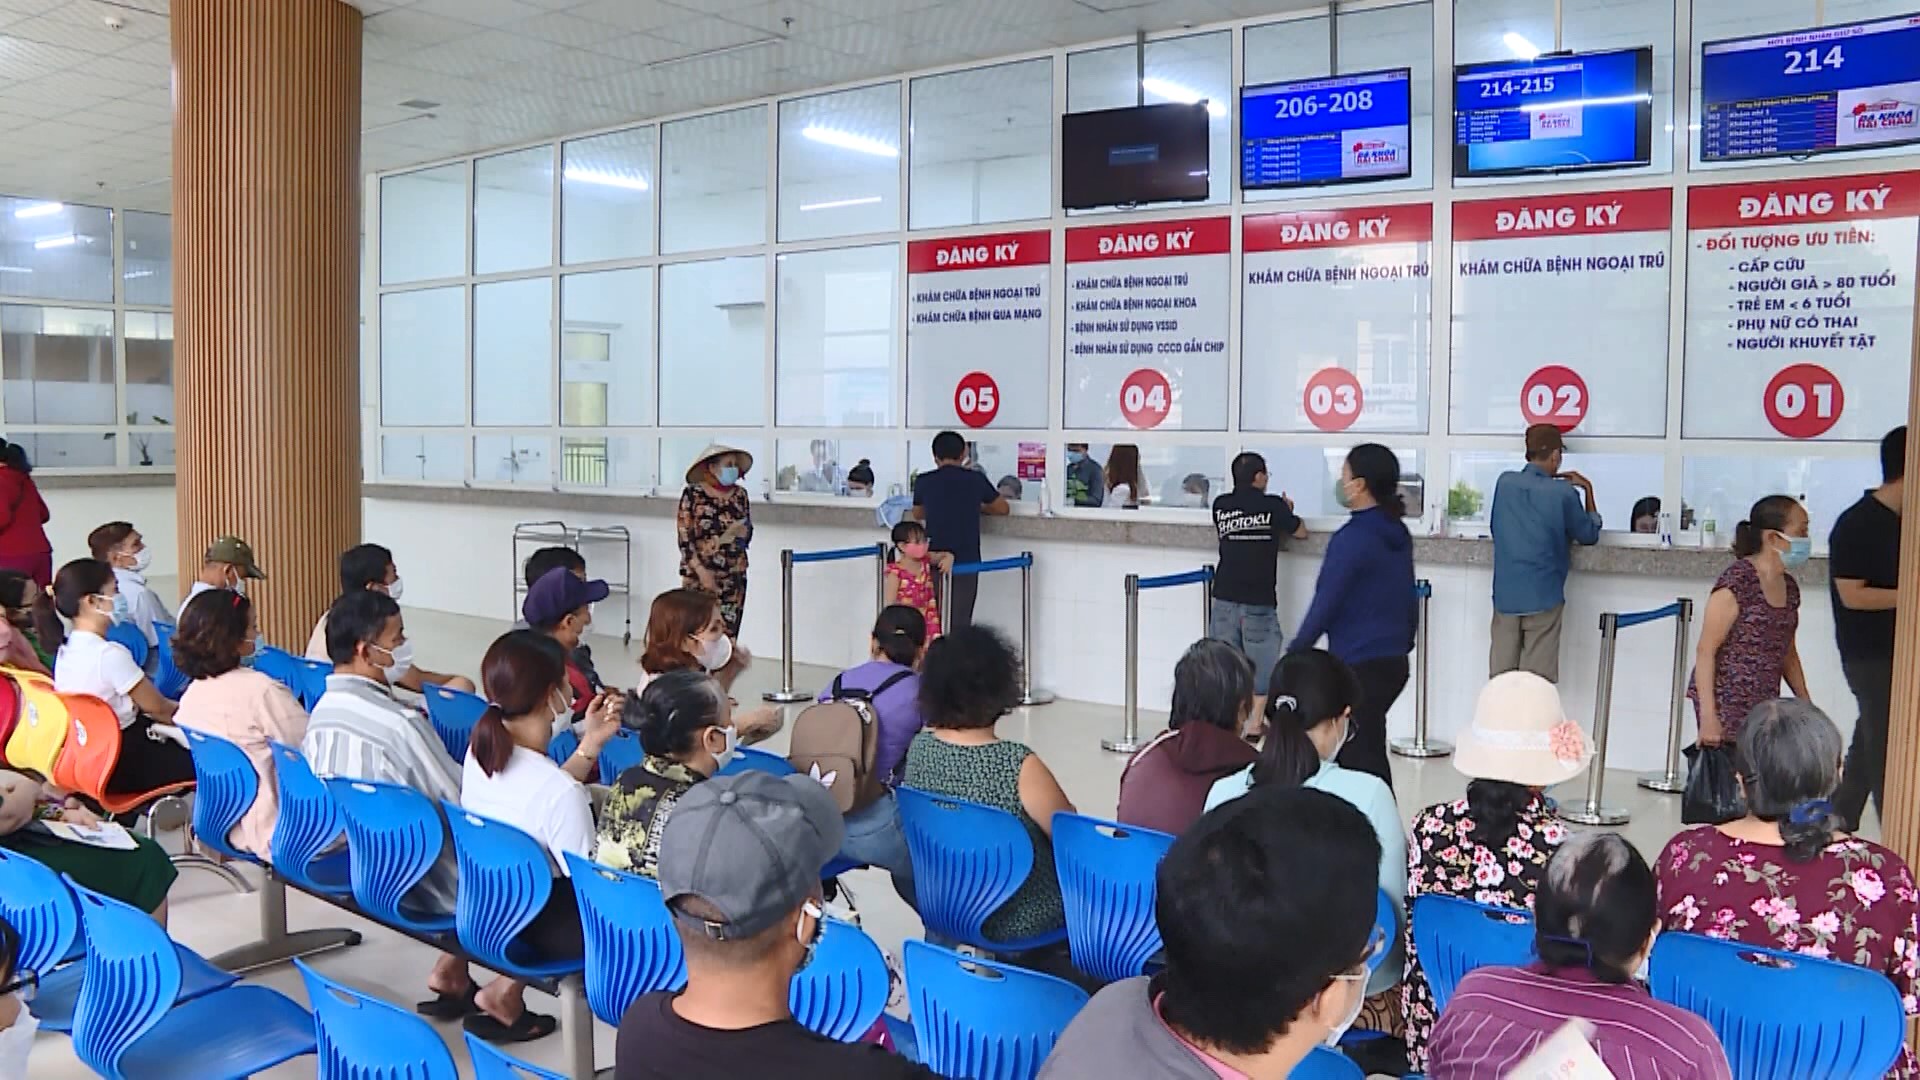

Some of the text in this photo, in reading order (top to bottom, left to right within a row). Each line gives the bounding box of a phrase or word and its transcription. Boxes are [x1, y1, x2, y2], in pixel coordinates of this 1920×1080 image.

[1784, 45, 1844, 74] 214
[1480, 77, 1555, 98] 214-215
[1275, 89, 1373, 119] 206-208
[1738, 183, 1891, 218] ĐĂNG KÝ
[1496, 200, 1622, 232] ĐĂNG KÝ
[1099, 227, 1194, 254] ĐĂNG KÝ
[1280, 214, 1390, 243] ĐĂNG KÝ
[1706, 227, 1875, 251] ĐỐI TƯỢNG ƯU TIÊN:
[936, 240, 1019, 265] ĐĂNG KÝ
[1460, 251, 1664, 276] KHÁM CHỮA BỆNH NGOẠI TRÚ
[1738, 256, 1805, 272] CẤP CỨU
[1249, 261, 1429, 285] KHÁM CHỮA BỆNH NGOẠI TRÚ
[1738, 277, 1786, 292] NGƯỜI
[1791, 275, 1818, 290] GIÀ
[1837, 276, 1855, 288] 80
[1859, 269, 1896, 288] TUỔI
[1173, 297, 1197, 308] KHOA
[1737, 295, 1760, 311] TRẺ
[1765, 299, 1784, 310] EM
[1802, 298, 1811, 309] 6
[1815, 291, 1850, 309] TUỔI
[993, 309, 1011, 321] QUA
[1155, 320, 1178, 331] VSSID
[1737, 314, 1858, 333] PHỤ NỮ CÓ THAI
[1157, 342, 1181, 353] CCCD
[1204, 341, 1224, 352] CHIP
[1736, 331, 1876, 350] NGƯỜI KHUYẾT TẬT
[958, 386, 995, 414] 05
[1124, 386, 1167, 413] 04
[1309, 384, 1357, 415] 03
[1527, 384, 1581, 416] 02
[1774, 383, 1833, 419] 01
[1217, 512, 1271, 534] SHOTOKU
